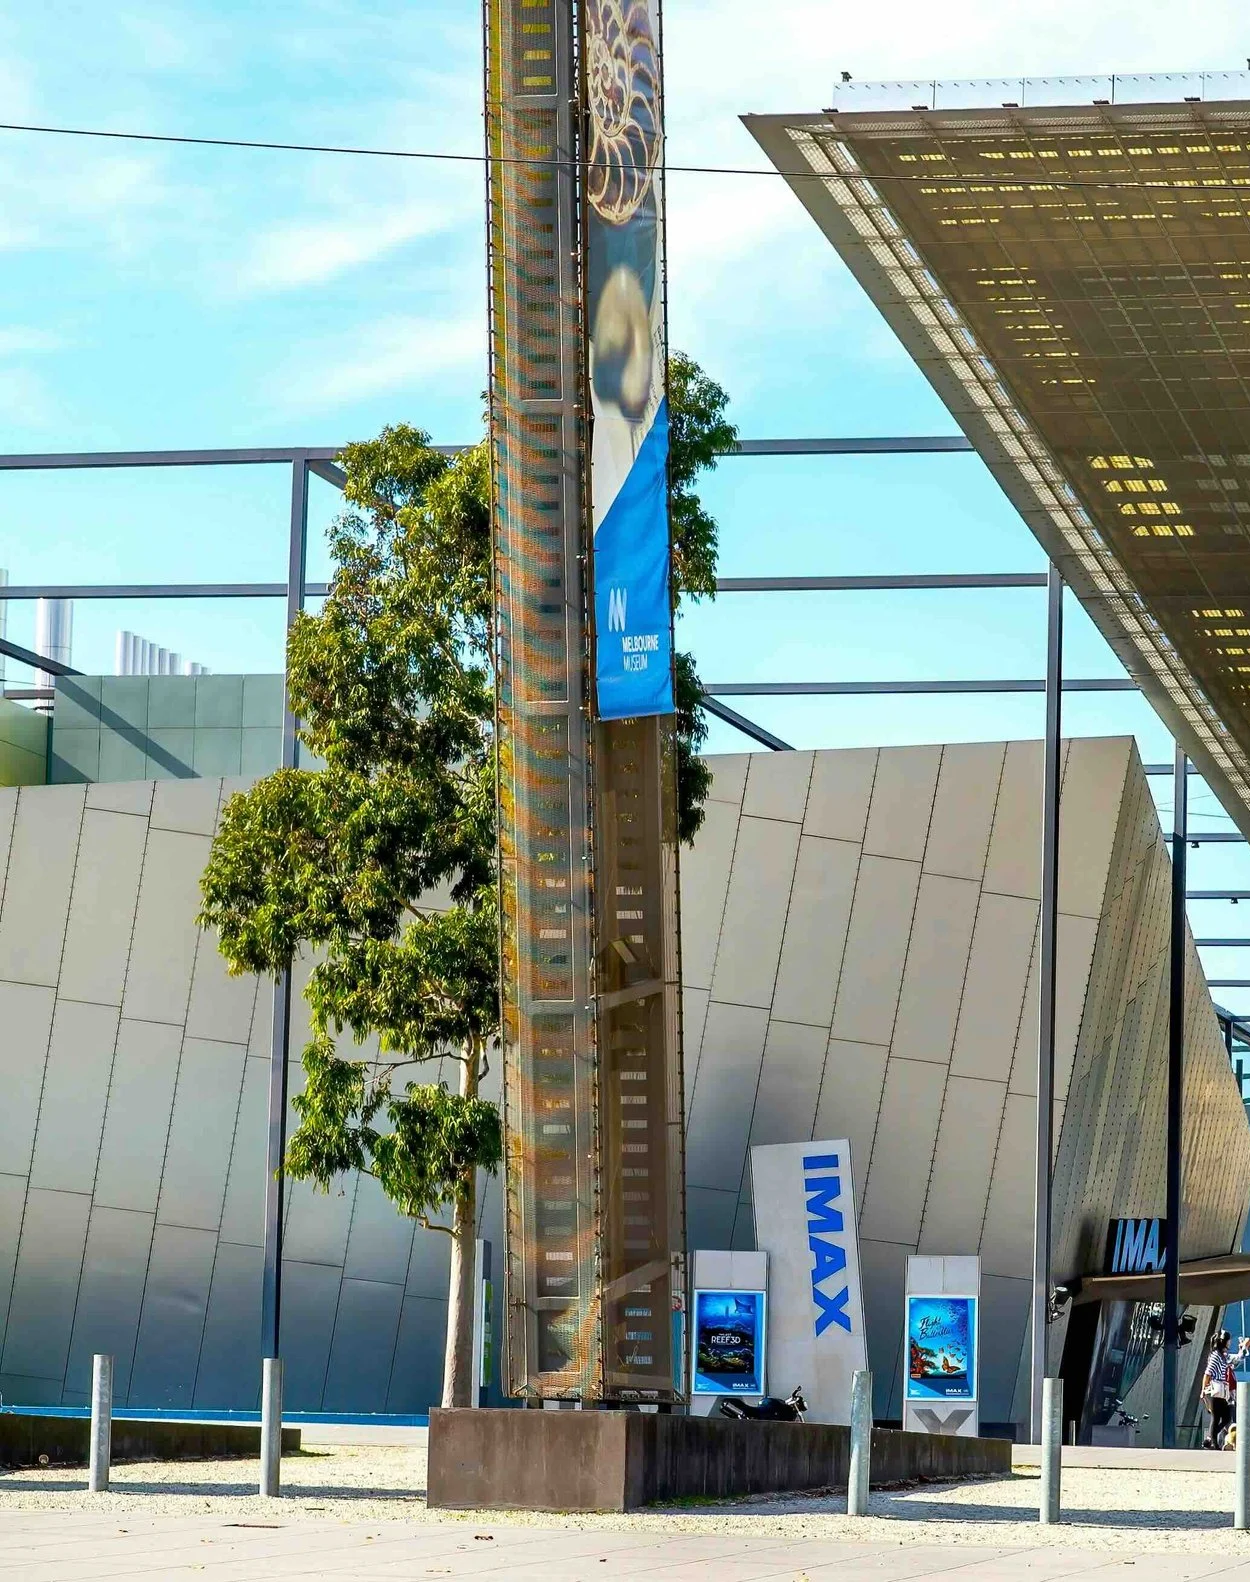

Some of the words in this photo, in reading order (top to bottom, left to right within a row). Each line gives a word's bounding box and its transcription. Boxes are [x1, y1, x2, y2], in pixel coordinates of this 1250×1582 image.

[622, 635, 659, 653] MELBOURNE
[624, 654, 648, 671] MUSEUM
[803, 1154, 851, 1337] IMAX
[1111, 1218, 1166, 1272] IMA
